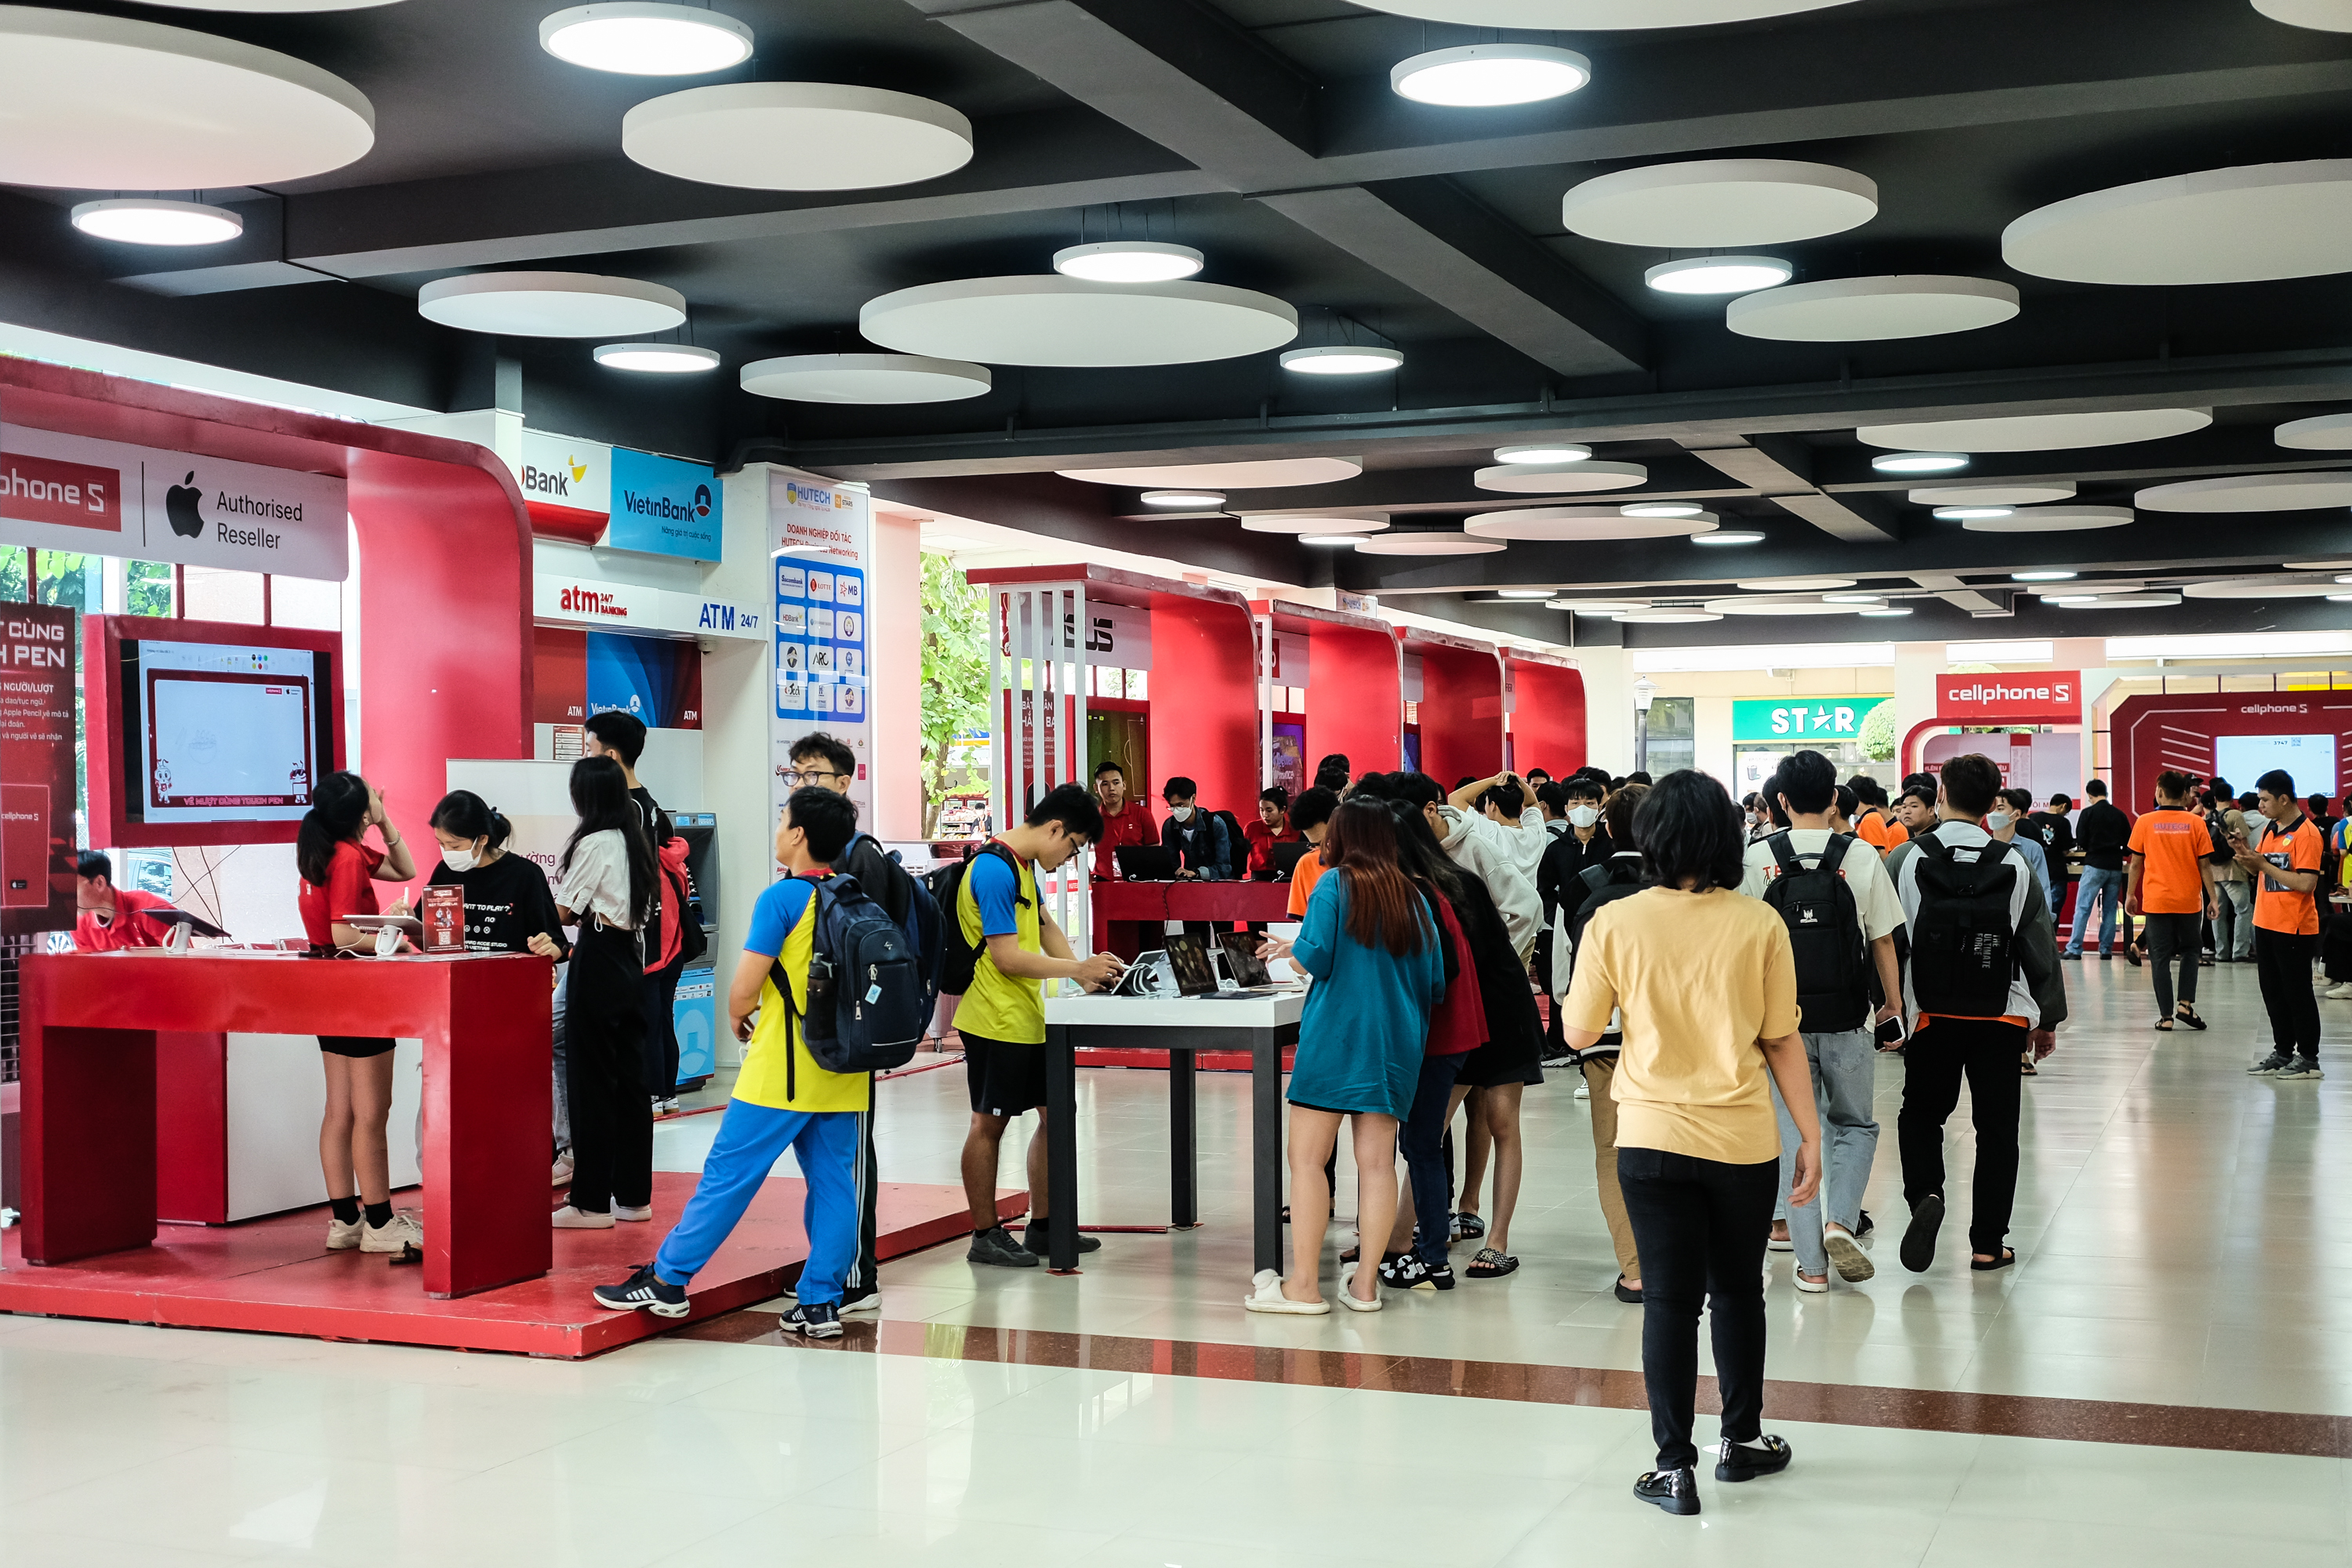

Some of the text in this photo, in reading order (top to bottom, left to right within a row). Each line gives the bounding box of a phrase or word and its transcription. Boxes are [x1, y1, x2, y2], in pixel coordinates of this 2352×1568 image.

[521, 463, 568, 497] Bank
[797, 486, 831, 504] HUTECH
[216, 491, 303, 521] Authorised
[624, 489, 695, 523] VietinBank
[217, 522, 281, 549] Reseller
[787, 523, 851, 543] DOANH NGHIỆP ĐỐI TÁC
[561, 585, 614, 613] atm 24/7
[848, 585, 858, 596] MB
[601, 604, 627, 616] BANKING
[699, 603, 759, 630] ATM 24/7
[782, 614, 799, 622] HDBank
[9, 618, 64, 641] CÙNG
[1051, 613, 1114, 652] SUS
[14, 644, 65, 667] PEN
[812, 652, 829, 666] ARC
[4, 681, 54, 695] NGƯỜI/LƯỢT
[1948, 684, 2049, 705] cellphone
[3, 709, 22, 717] Apple
[568, 706, 583, 717] ATM
[684, 710, 698, 720] ATM
[2, 811, 33, 821] cellphone
[1973, 933, 1984, 956] FORCE
[1981, 933, 1992, 969] ULTIMATE
[1992, 935, 2001, 947] THE
